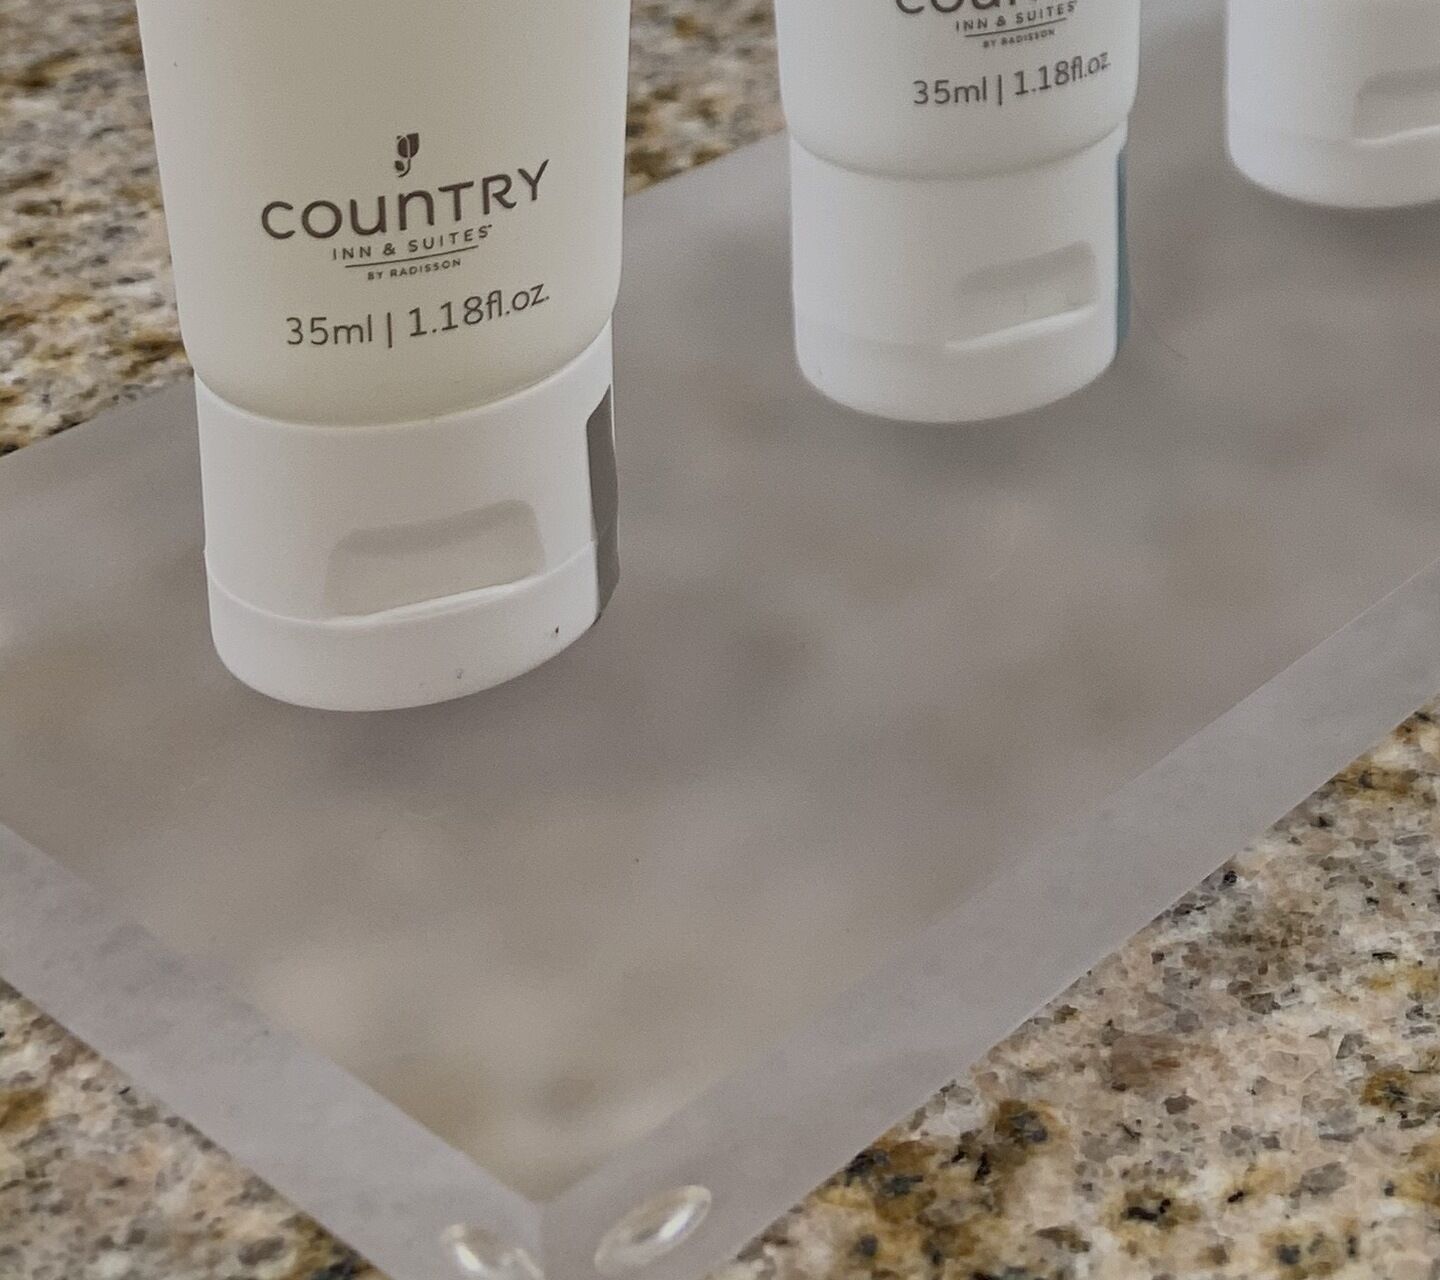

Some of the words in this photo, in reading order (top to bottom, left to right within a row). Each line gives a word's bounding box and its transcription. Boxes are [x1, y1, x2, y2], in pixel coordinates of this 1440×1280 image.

[956, 17, 988, 32] INN
[912, 75, 987, 105] 35ml
[331, 245, 372, 261] INN
[383, 242, 396, 256] &
[408, 225, 491, 253] SUITES
[367, 271, 384, 281] BY
[390, 258, 462, 278] RADISSON
[285, 313, 372, 346] 35ml
